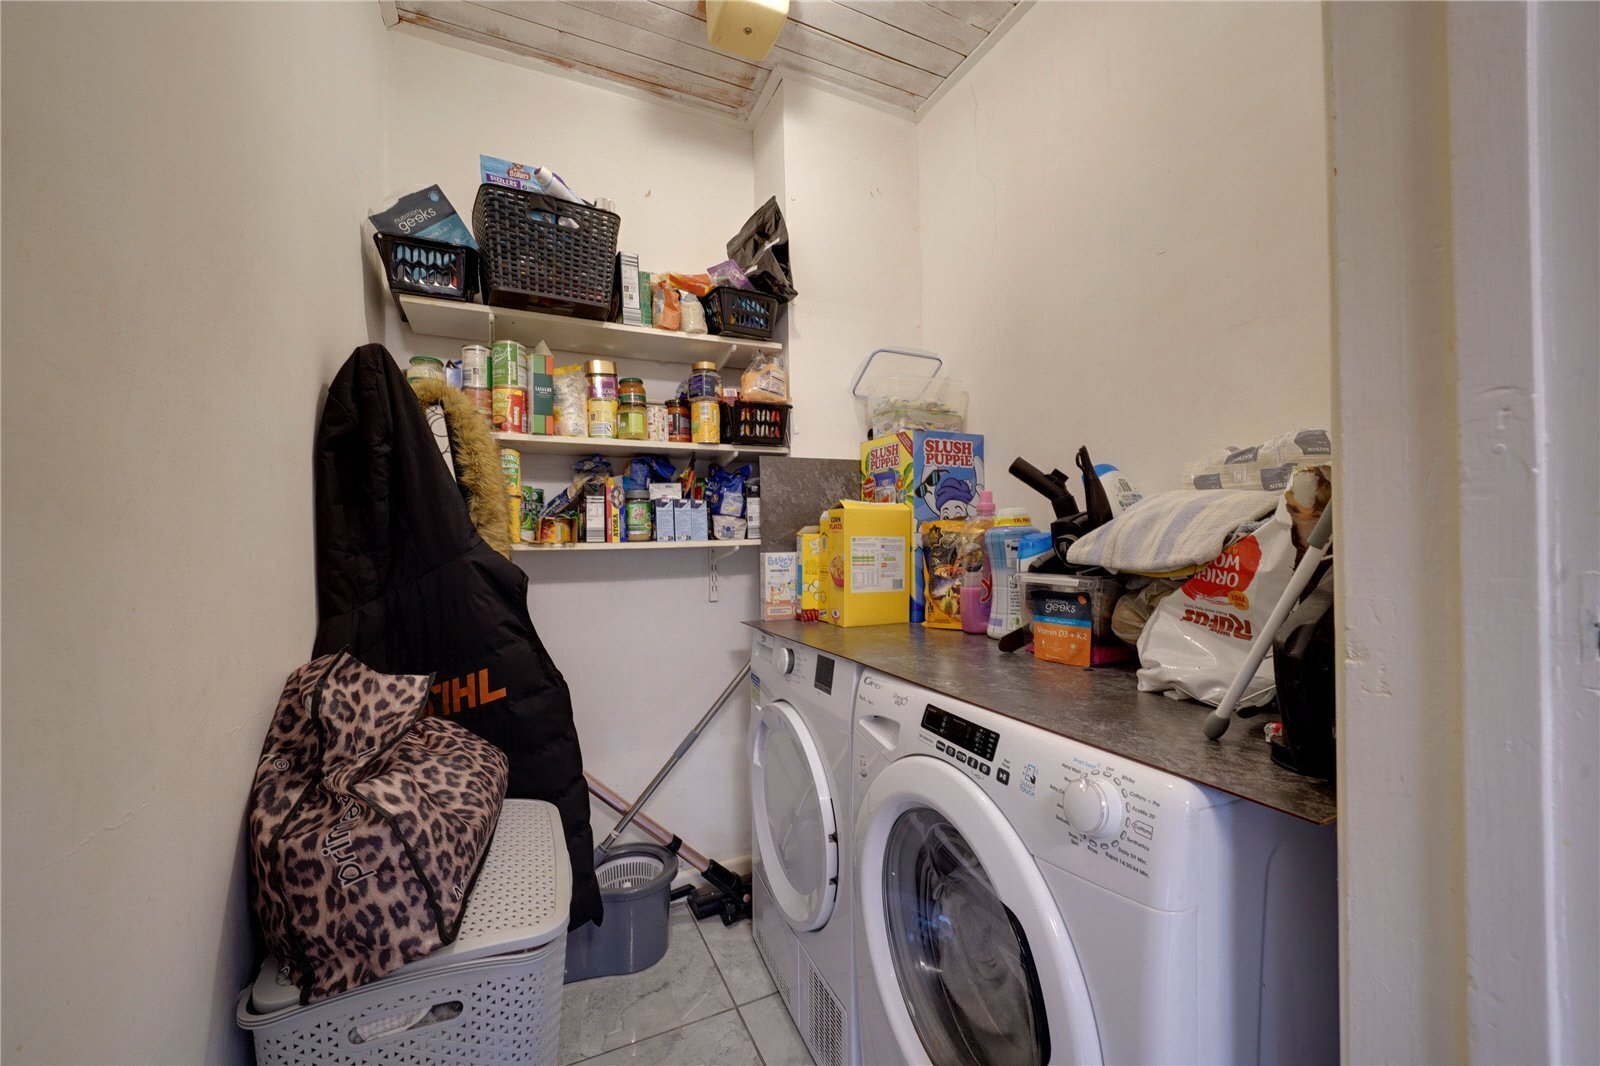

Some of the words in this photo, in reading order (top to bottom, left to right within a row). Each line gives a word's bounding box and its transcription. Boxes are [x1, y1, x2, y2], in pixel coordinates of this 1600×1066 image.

[394, 209, 422, 223] nutrition
[398, 208, 437, 234] geeks
[870, 443, 899, 461] SLUSH
[925, 439, 972, 455] SLUSH
[1045, 602, 1076, 614] geeks
[1036, 625, 1057, 636] Vitamin
[1058, 630, 1069, 638] D3
[1076, 632, 1088, 641] K2
[1129, 791, 1147, 802] Cottons
[1134, 823, 1152, 835] Cottons
[1126, 836, 1150, 851] Synthetics
[1105, 851, 1119, 862] Rapid
[1118, 847, 1129, 857] Daily
